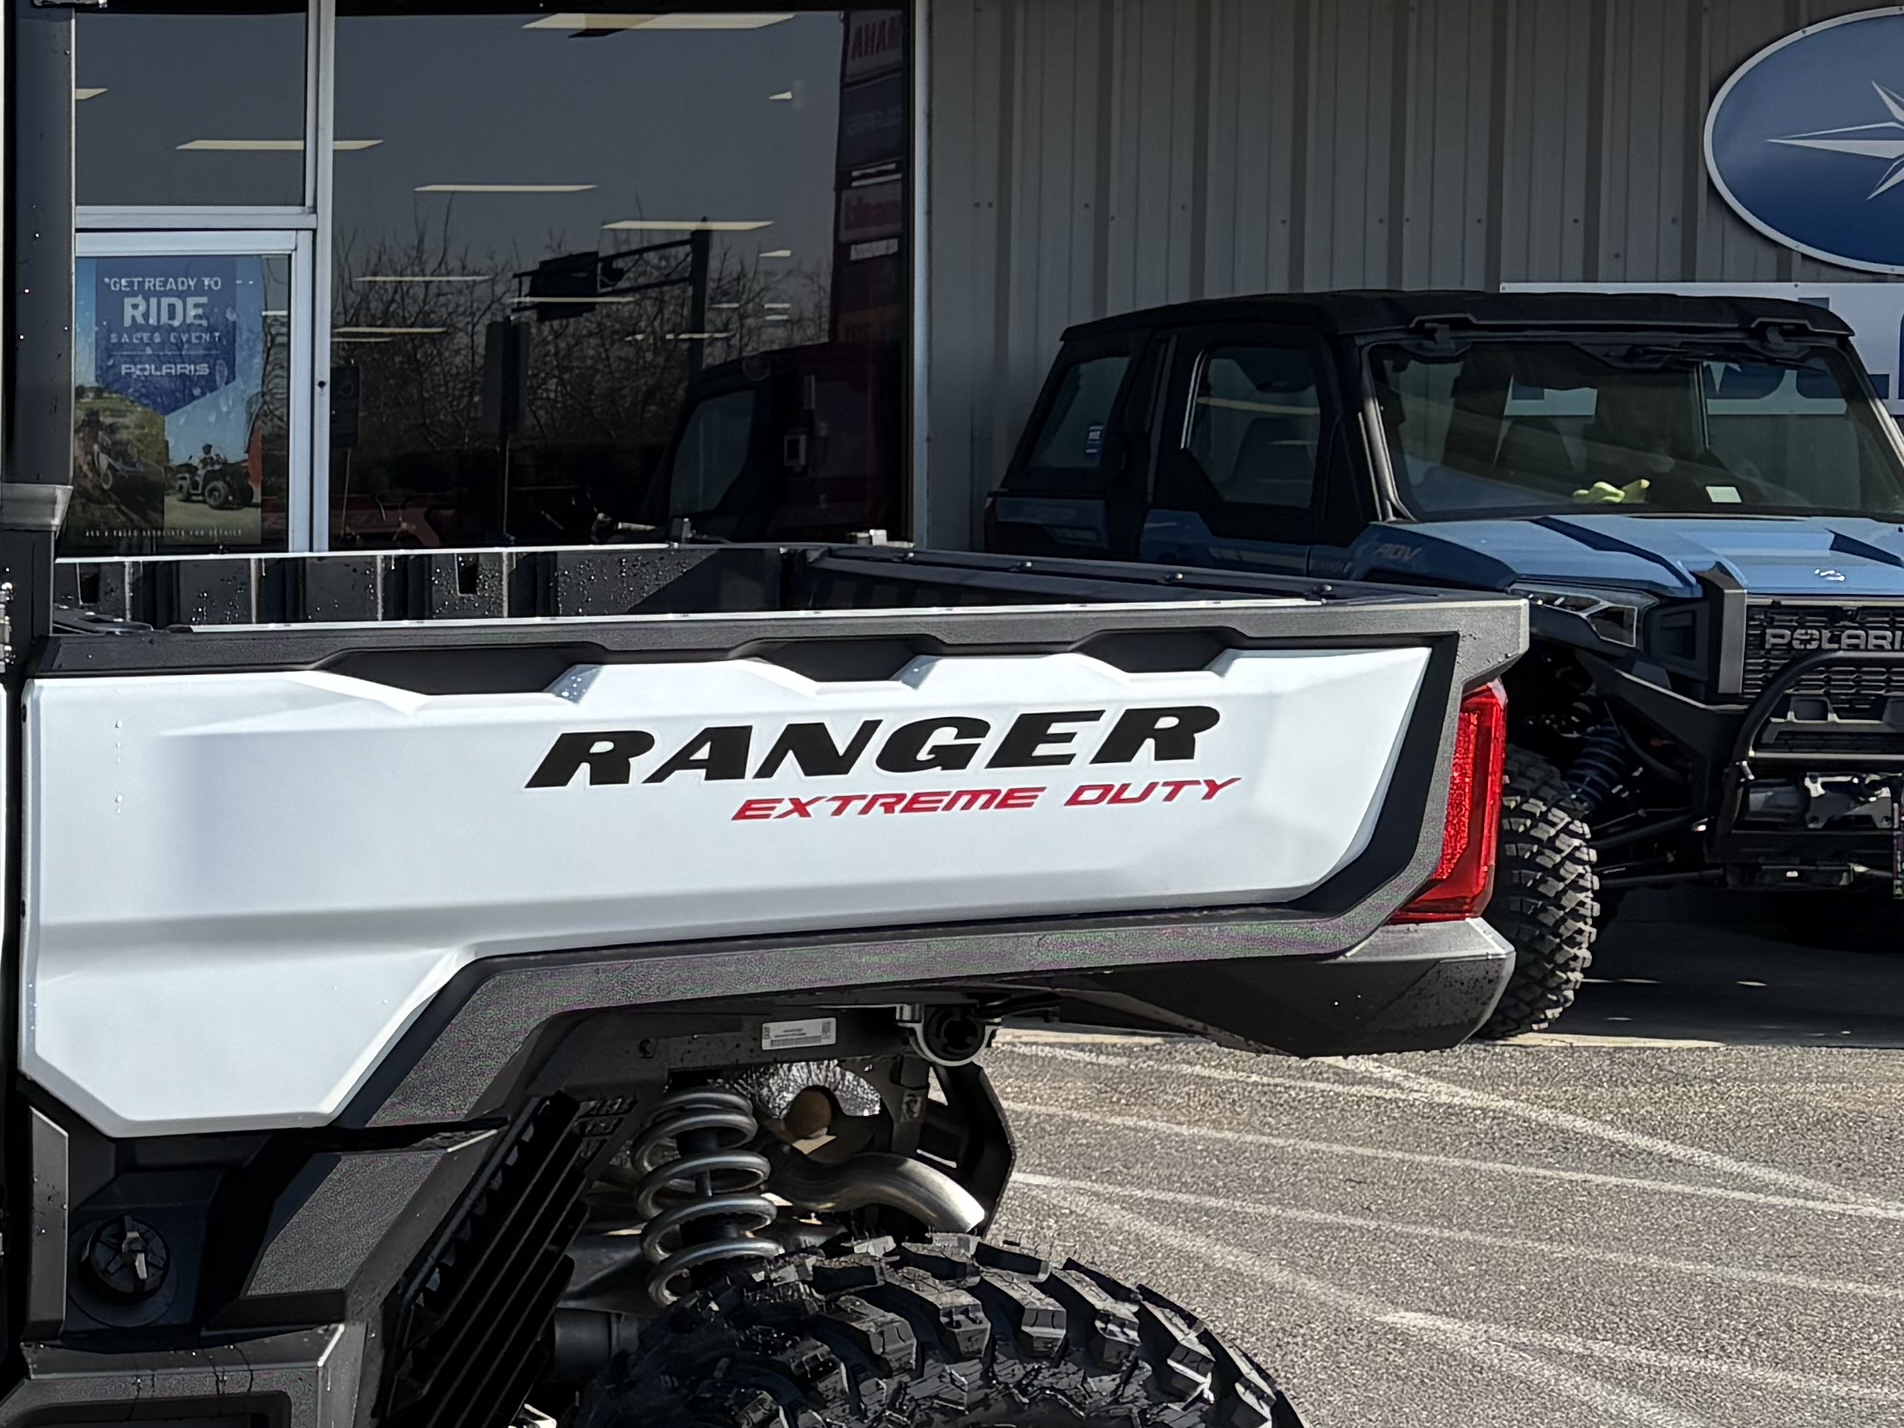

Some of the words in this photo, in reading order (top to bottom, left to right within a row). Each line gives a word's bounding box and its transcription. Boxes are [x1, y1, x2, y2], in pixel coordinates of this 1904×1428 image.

[109, 277, 143, 291] GET
[144, 277, 197, 291] READY
[201, 277, 221, 291] TO
[123, 295, 208, 328] RIDE
[109, 332, 162, 344] SALES
[169, 332, 221, 344] EVENT
[121, 363, 210, 376] POLARIS
[1764, 628, 1904, 651] POLARI
[524, 705, 1221, 789] RANGER
[731, 783, 1046, 822] EXTREME
[1062, 776, 1243, 810] DUTY
